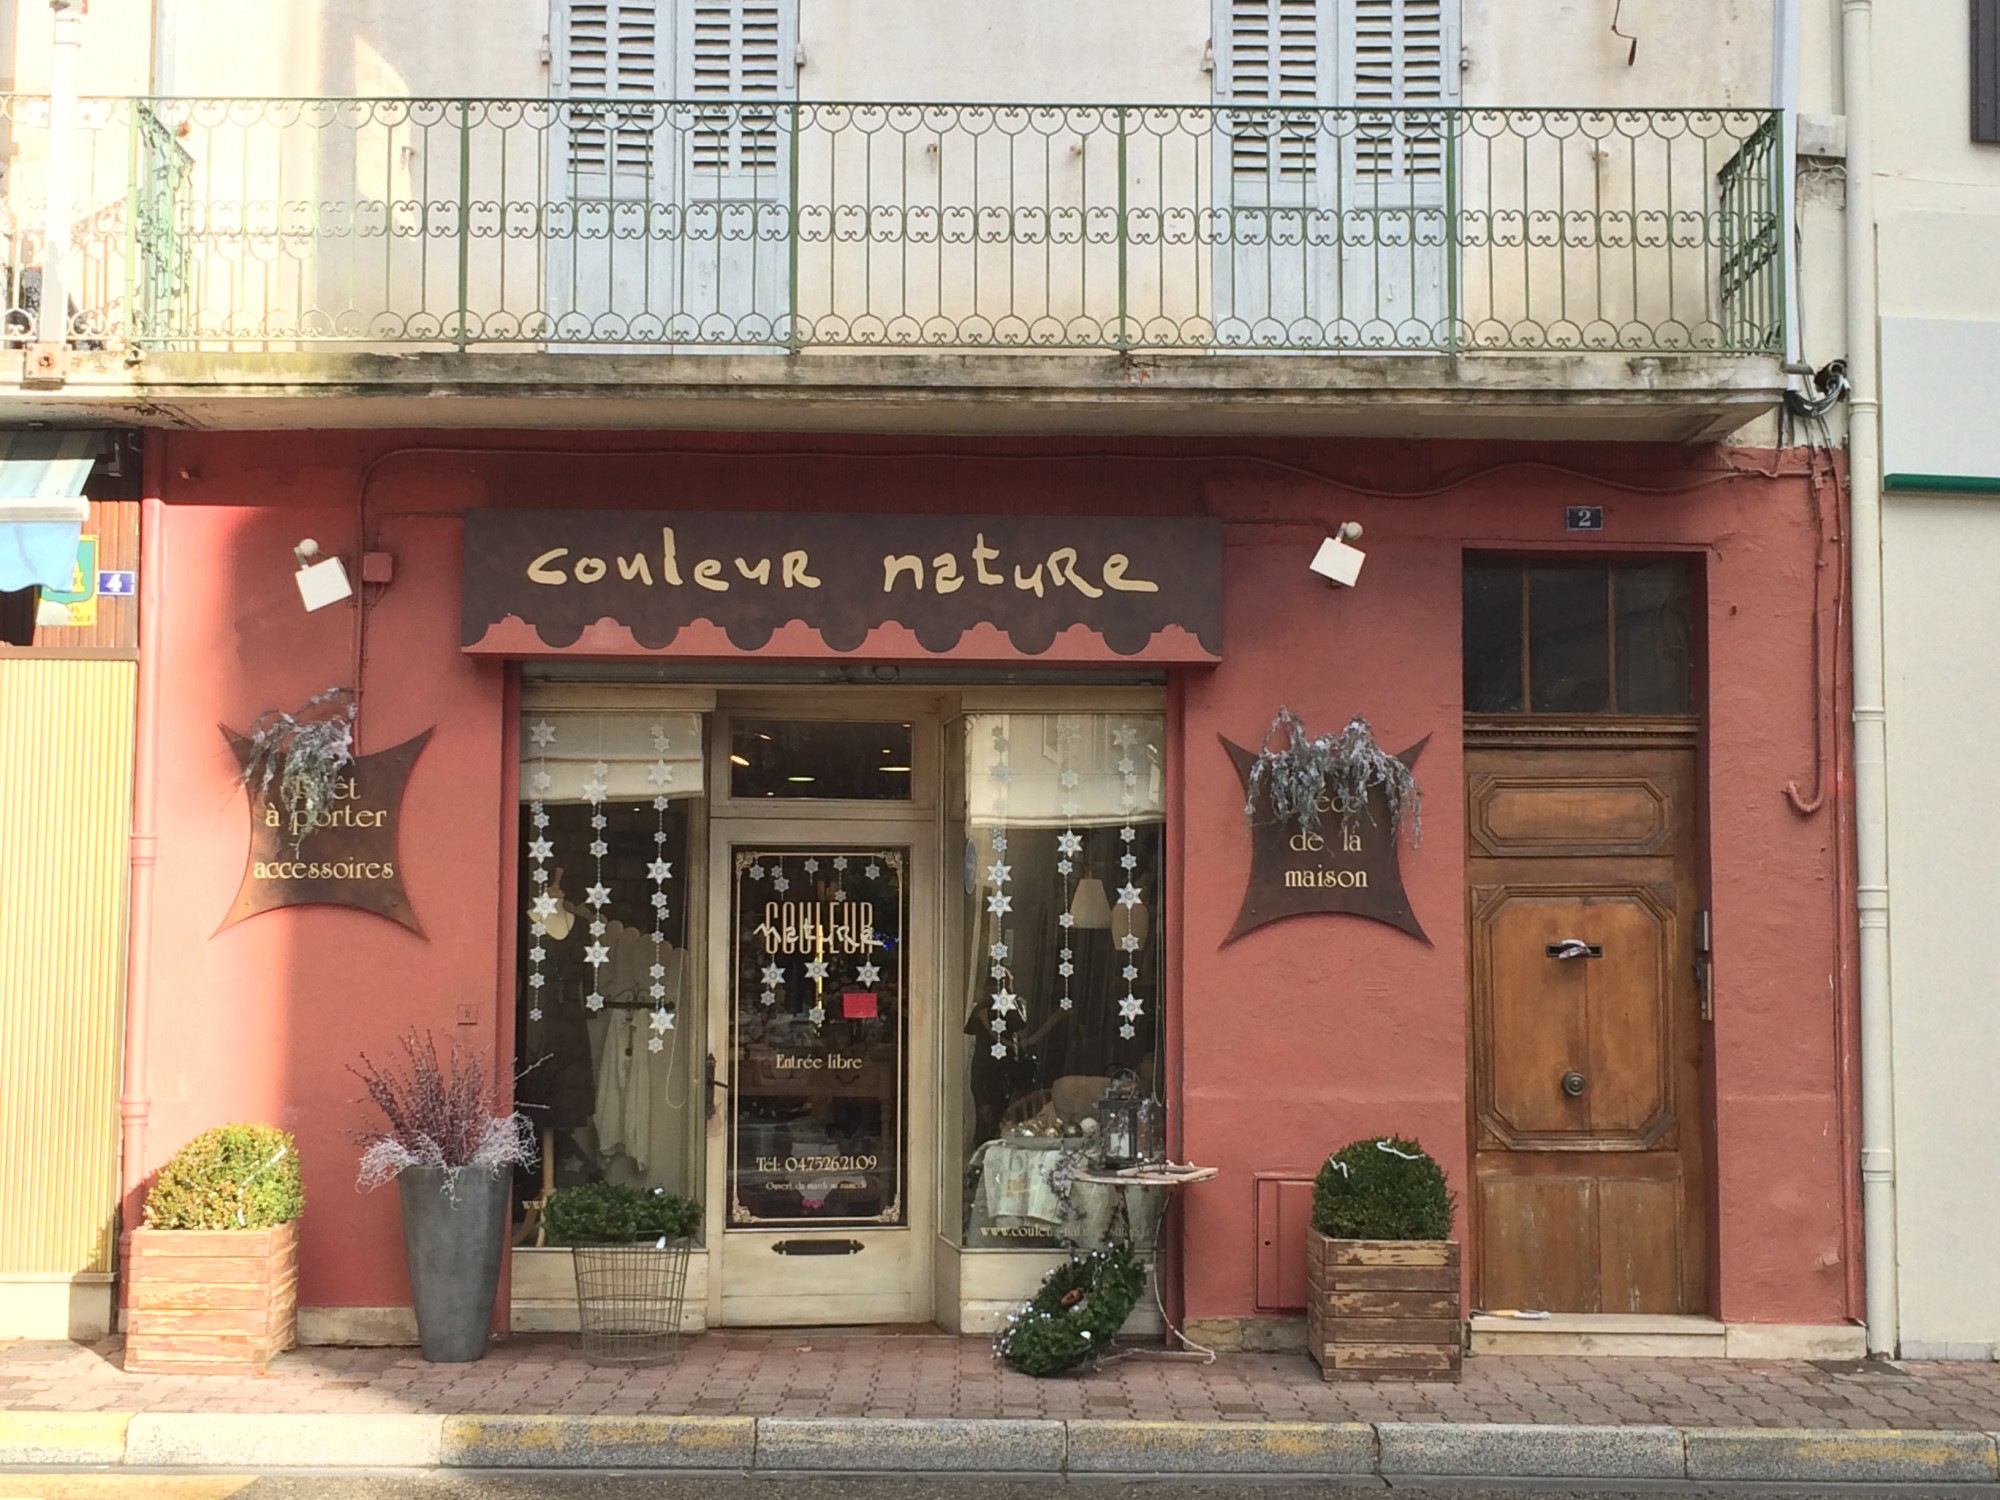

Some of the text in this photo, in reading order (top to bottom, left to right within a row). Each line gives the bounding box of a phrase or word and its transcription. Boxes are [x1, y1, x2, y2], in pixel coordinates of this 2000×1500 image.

[1578, 509, 1592, 527] 2
[105, 572, 123, 592] 4
[265, 802, 387, 836] à porter
[1289, 826, 1363, 852] de la
[253, 856, 394, 880] accessoires
[1284, 863, 1369, 888] maison
[765, 901, 873, 954] COULEUR
[775, 1053, 863, 1070] Entrée libre
